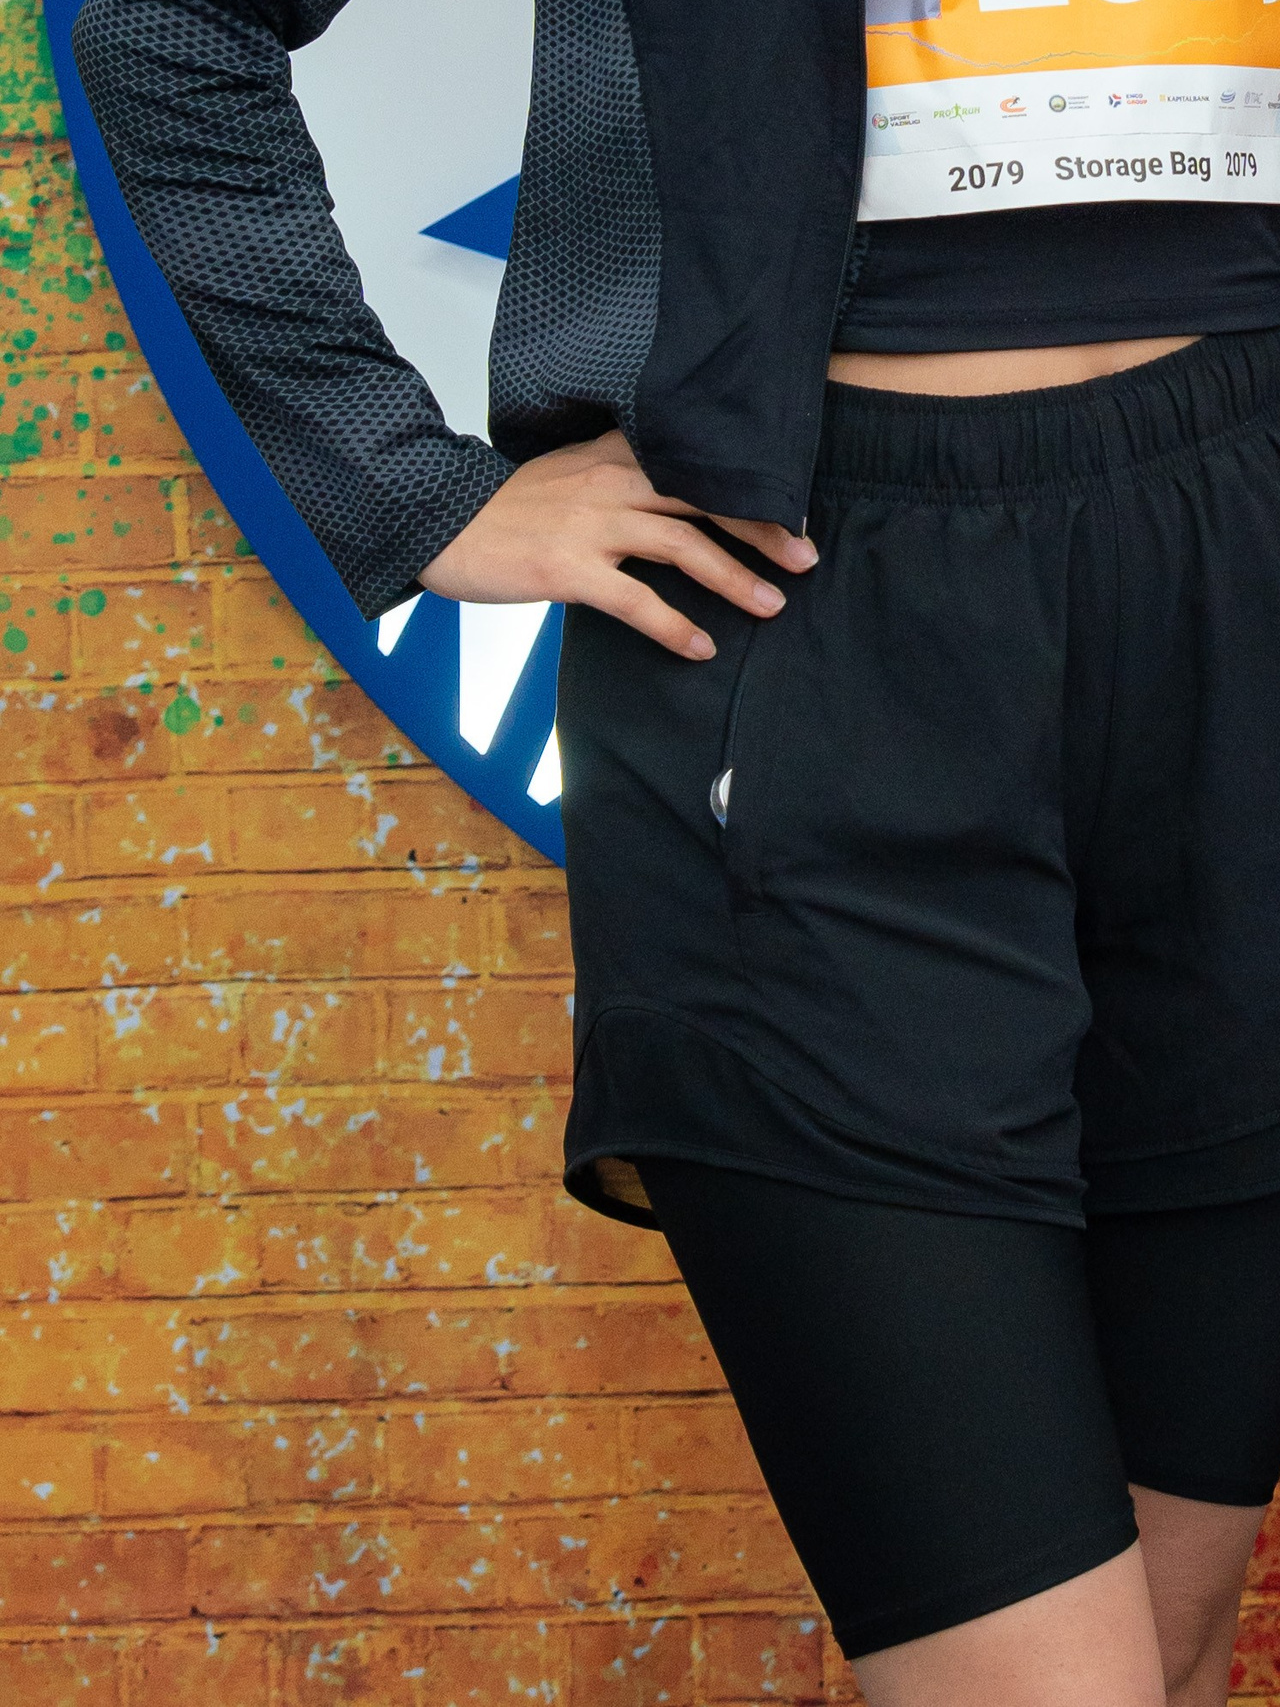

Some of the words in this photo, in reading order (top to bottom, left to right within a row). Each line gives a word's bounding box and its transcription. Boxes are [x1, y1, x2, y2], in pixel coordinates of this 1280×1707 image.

[948, 160, 1024, 192] 2079
[1054, 153, 1163, 183] Storage
[1170, 151, 1211, 182] Bag
[1225, 151, 1257, 177] 2079
